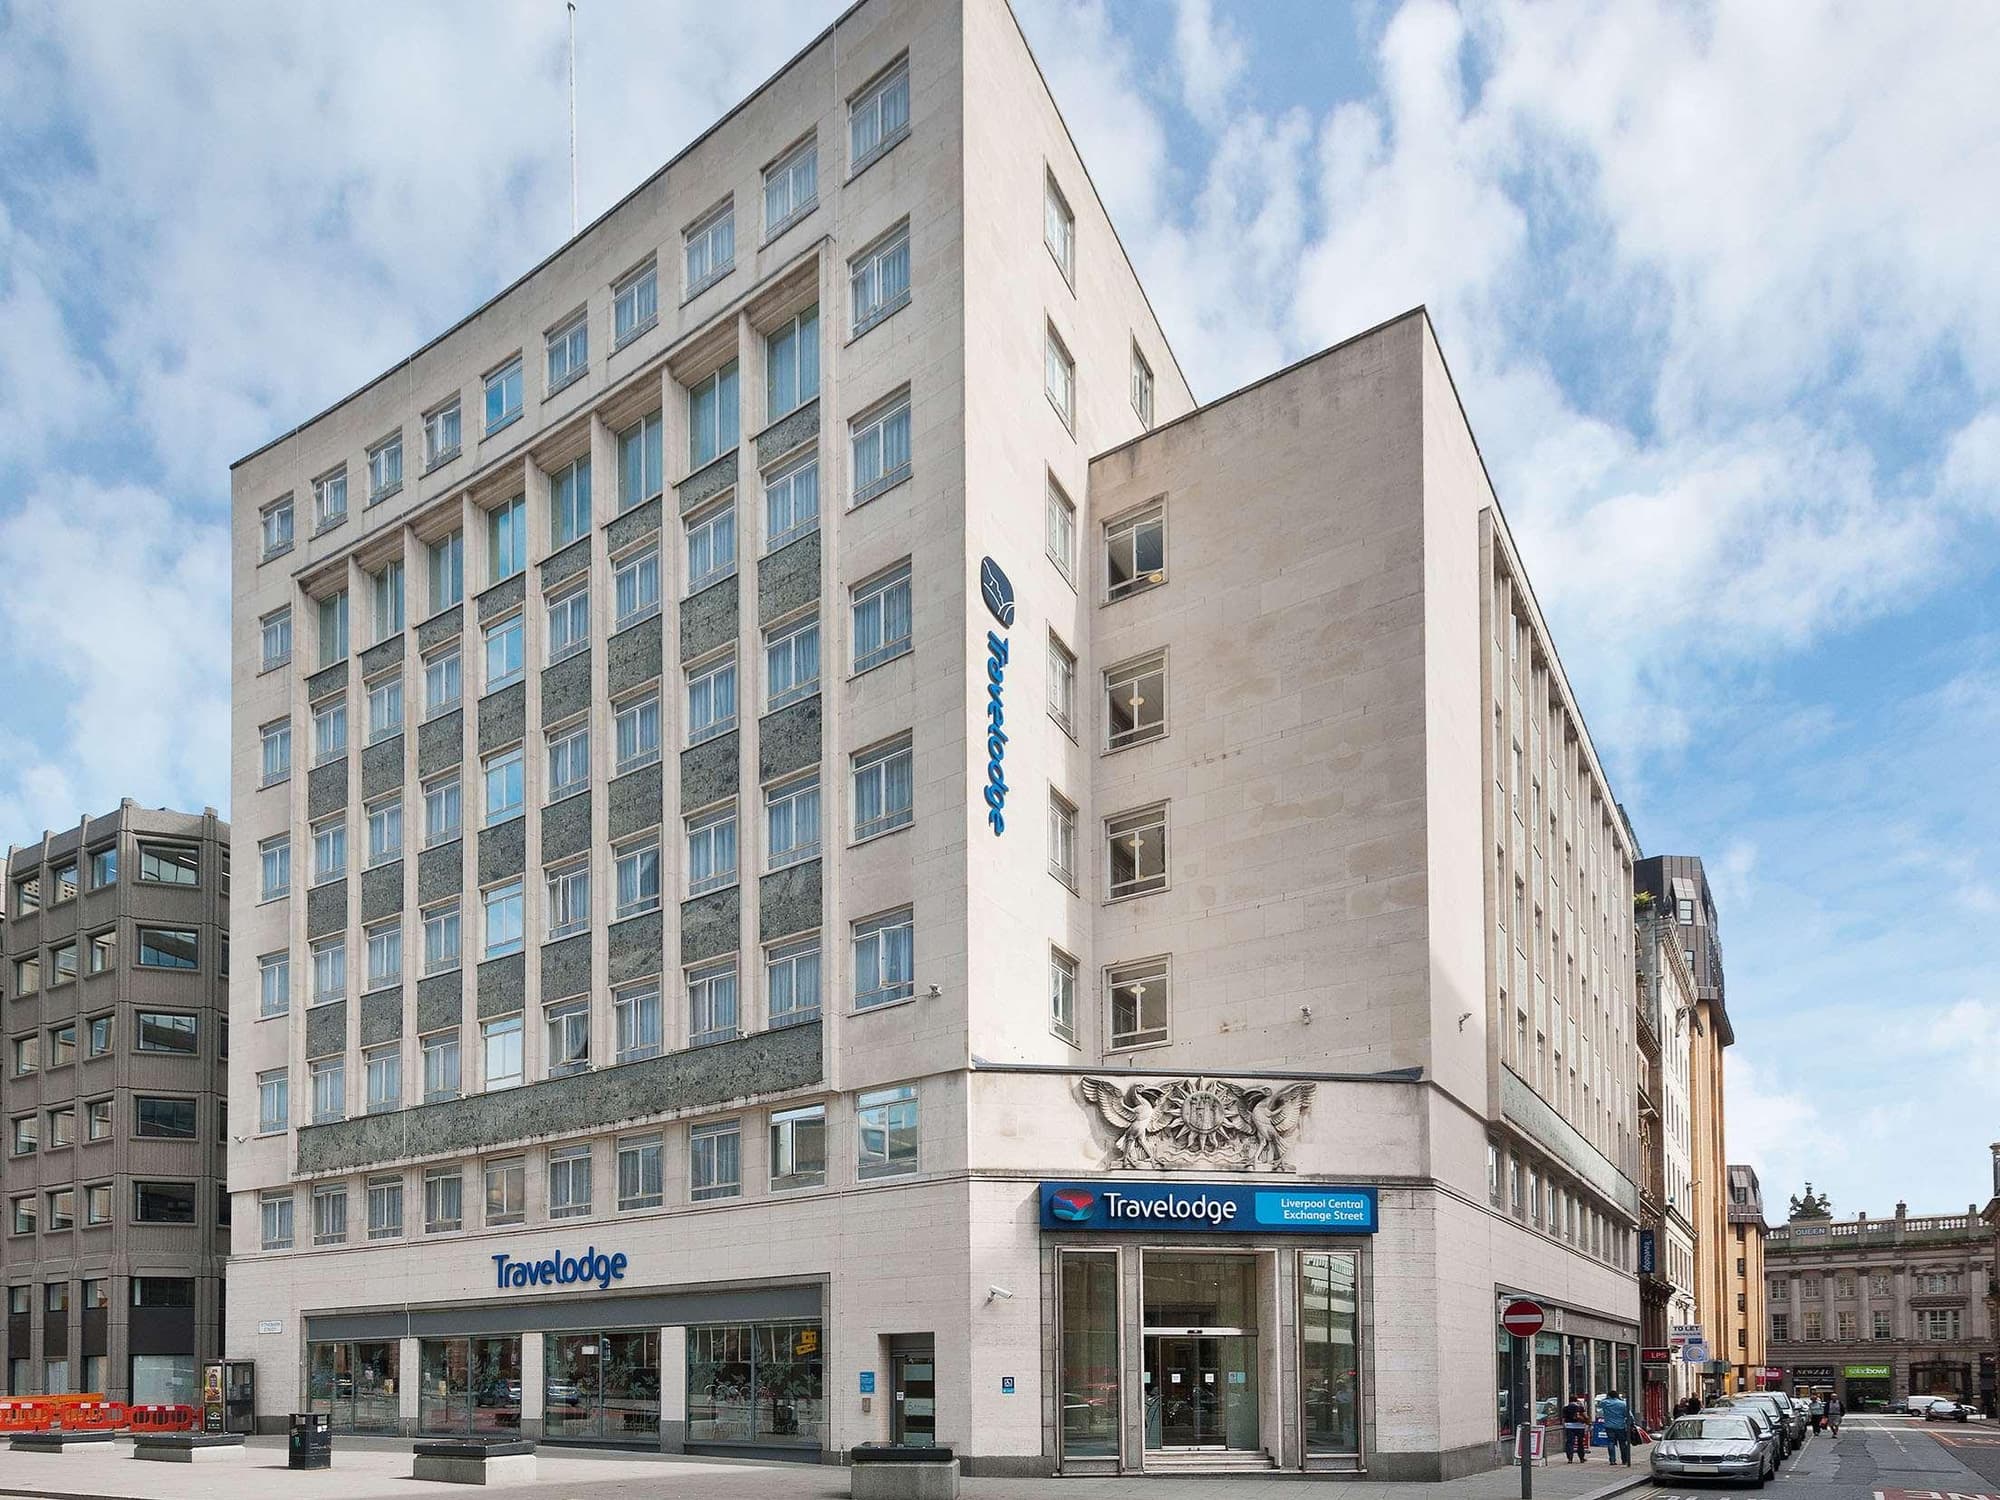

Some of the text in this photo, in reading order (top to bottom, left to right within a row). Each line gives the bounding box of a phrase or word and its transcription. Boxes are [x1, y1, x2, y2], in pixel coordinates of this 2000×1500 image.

[984, 630, 1009, 837] Travelodge
[1103, 1192, 1237, 1225] Travelodge
[1281, 1198, 1364, 1210] Liverpool Central
[1283, 1210, 1364, 1222] Exchange Street
[491, 1246, 628, 1289] Travelodge
